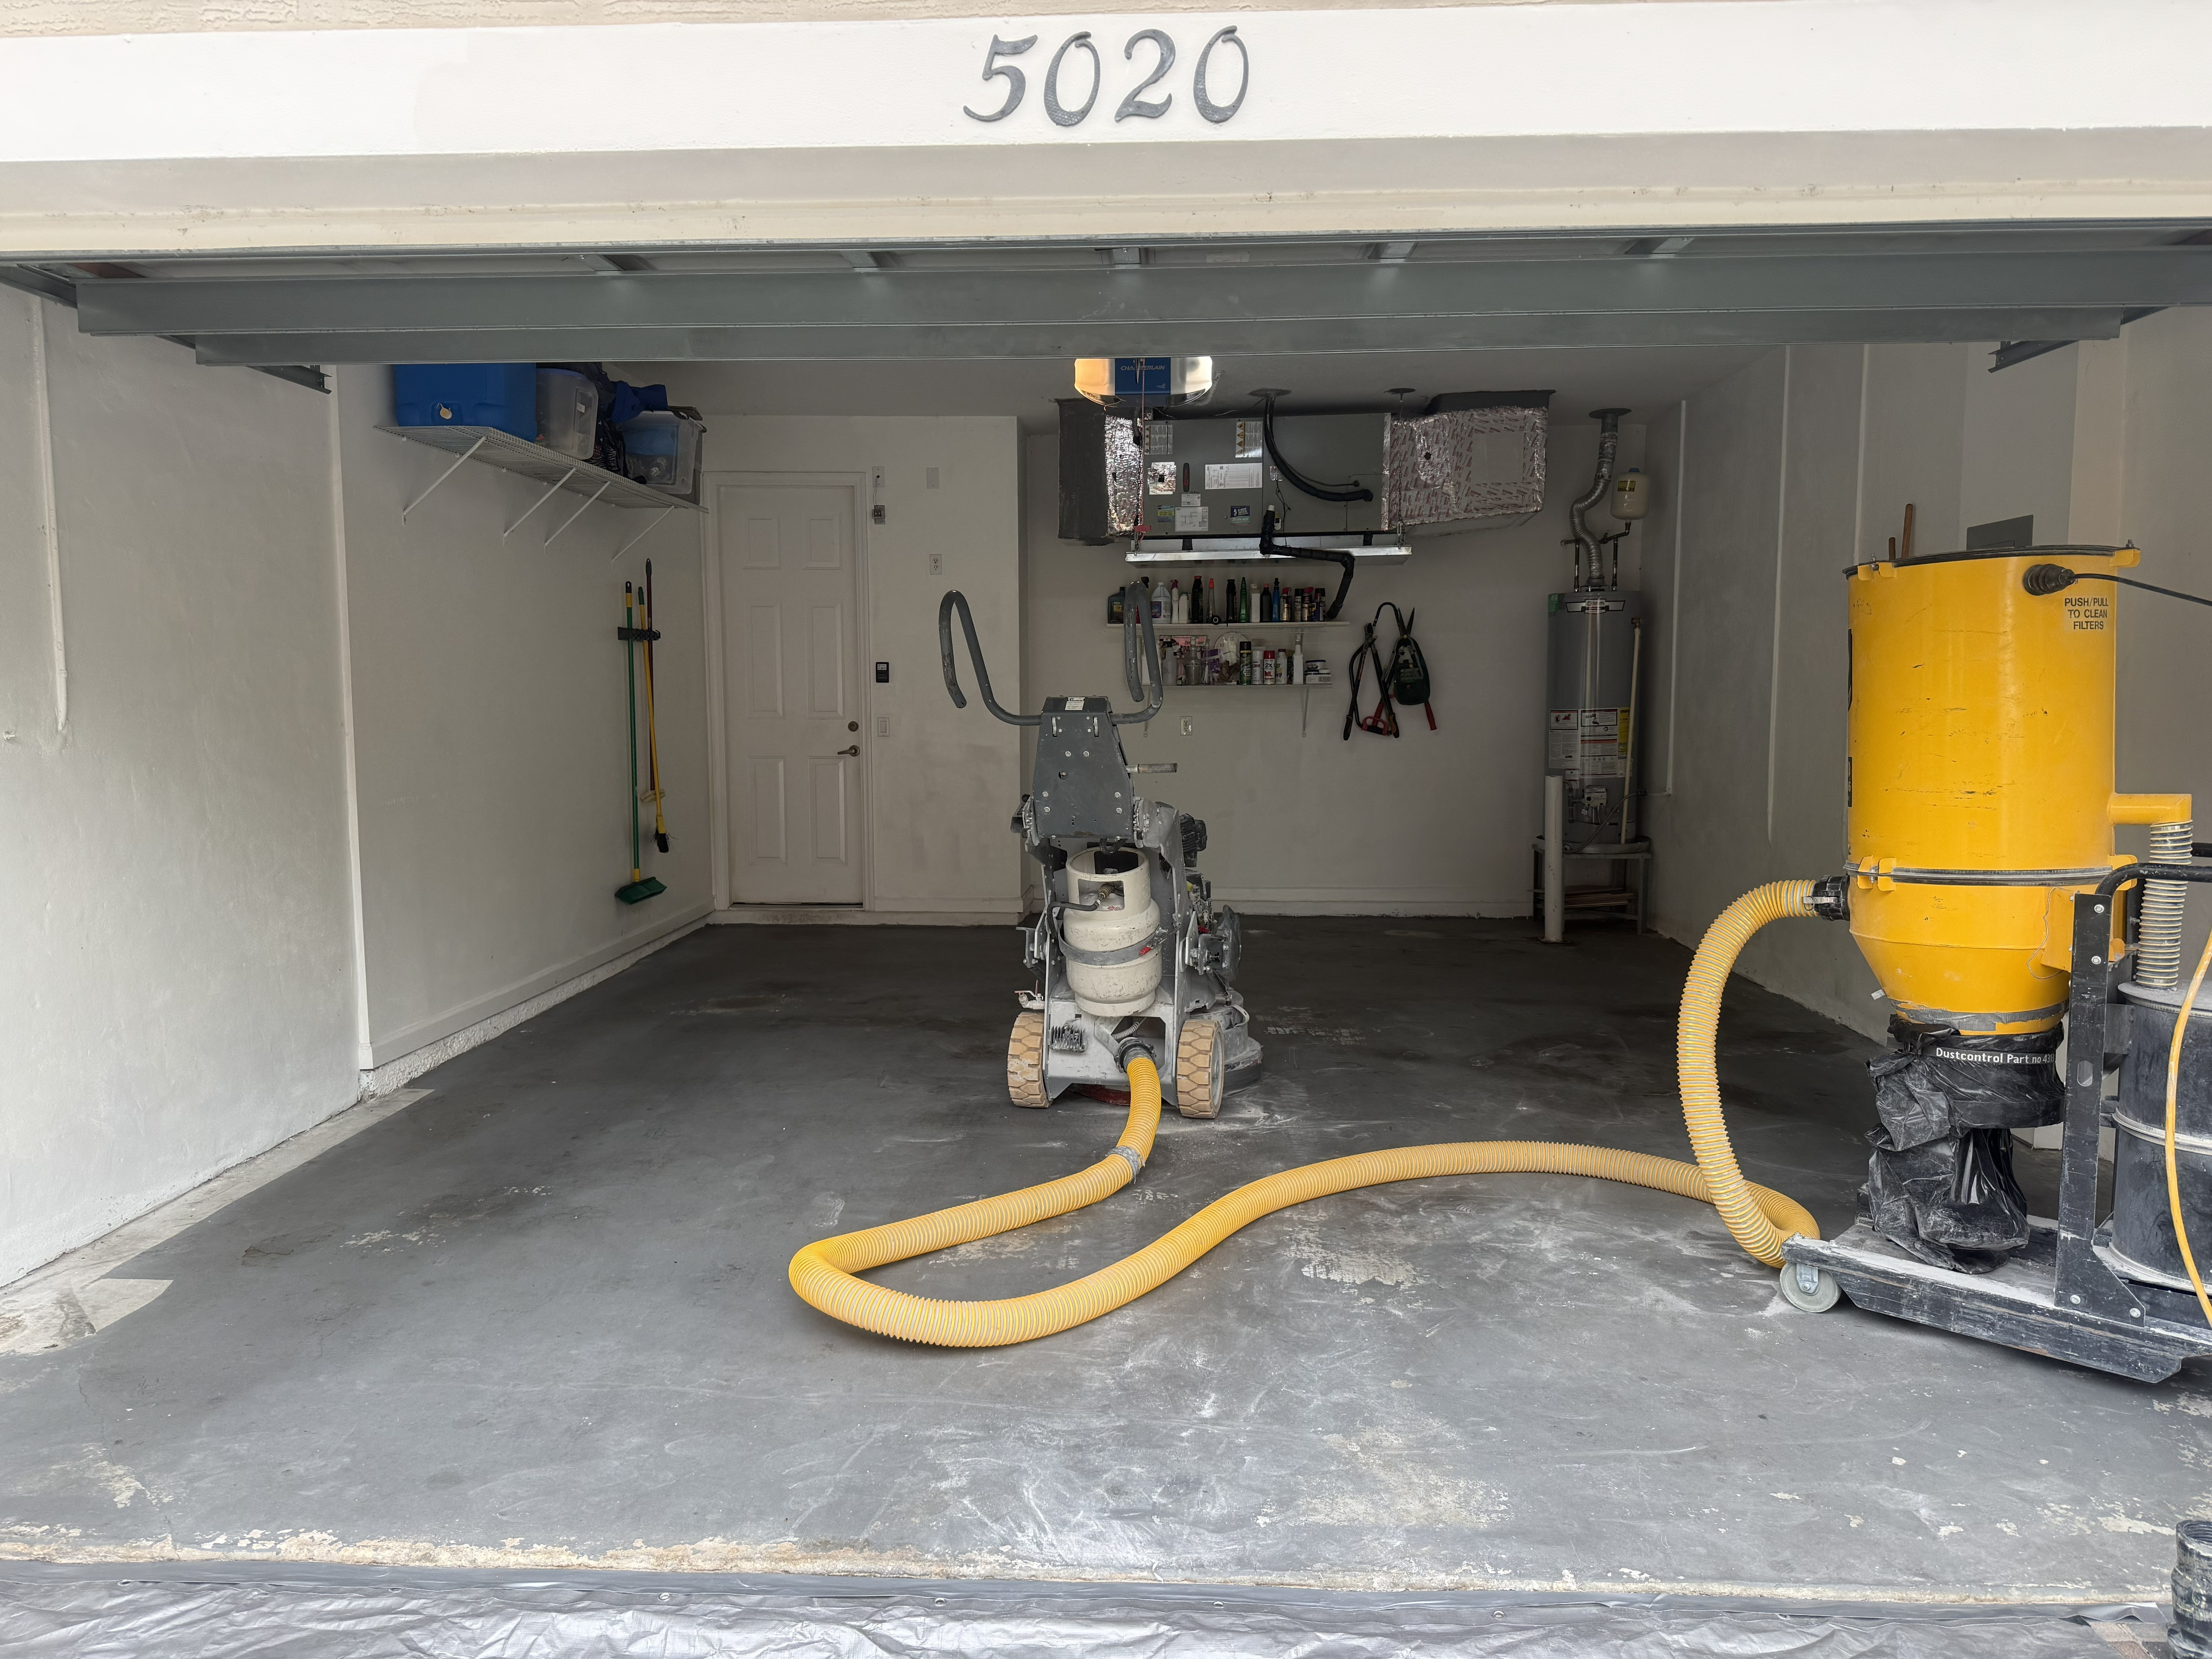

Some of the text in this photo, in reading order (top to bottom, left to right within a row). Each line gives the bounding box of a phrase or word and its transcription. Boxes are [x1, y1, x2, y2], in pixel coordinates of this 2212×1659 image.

[963, 25, 1249, 127] 5020
[2064, 597, 2109, 607] PUSH/PULL
[2068, 609, 2107, 618] TO CLEAN
[2073, 621, 2104, 630] FILTERS
[1936, 1047, 2003, 1063] Dustcontrol
[2007, 1054, 2029, 1064] Part
